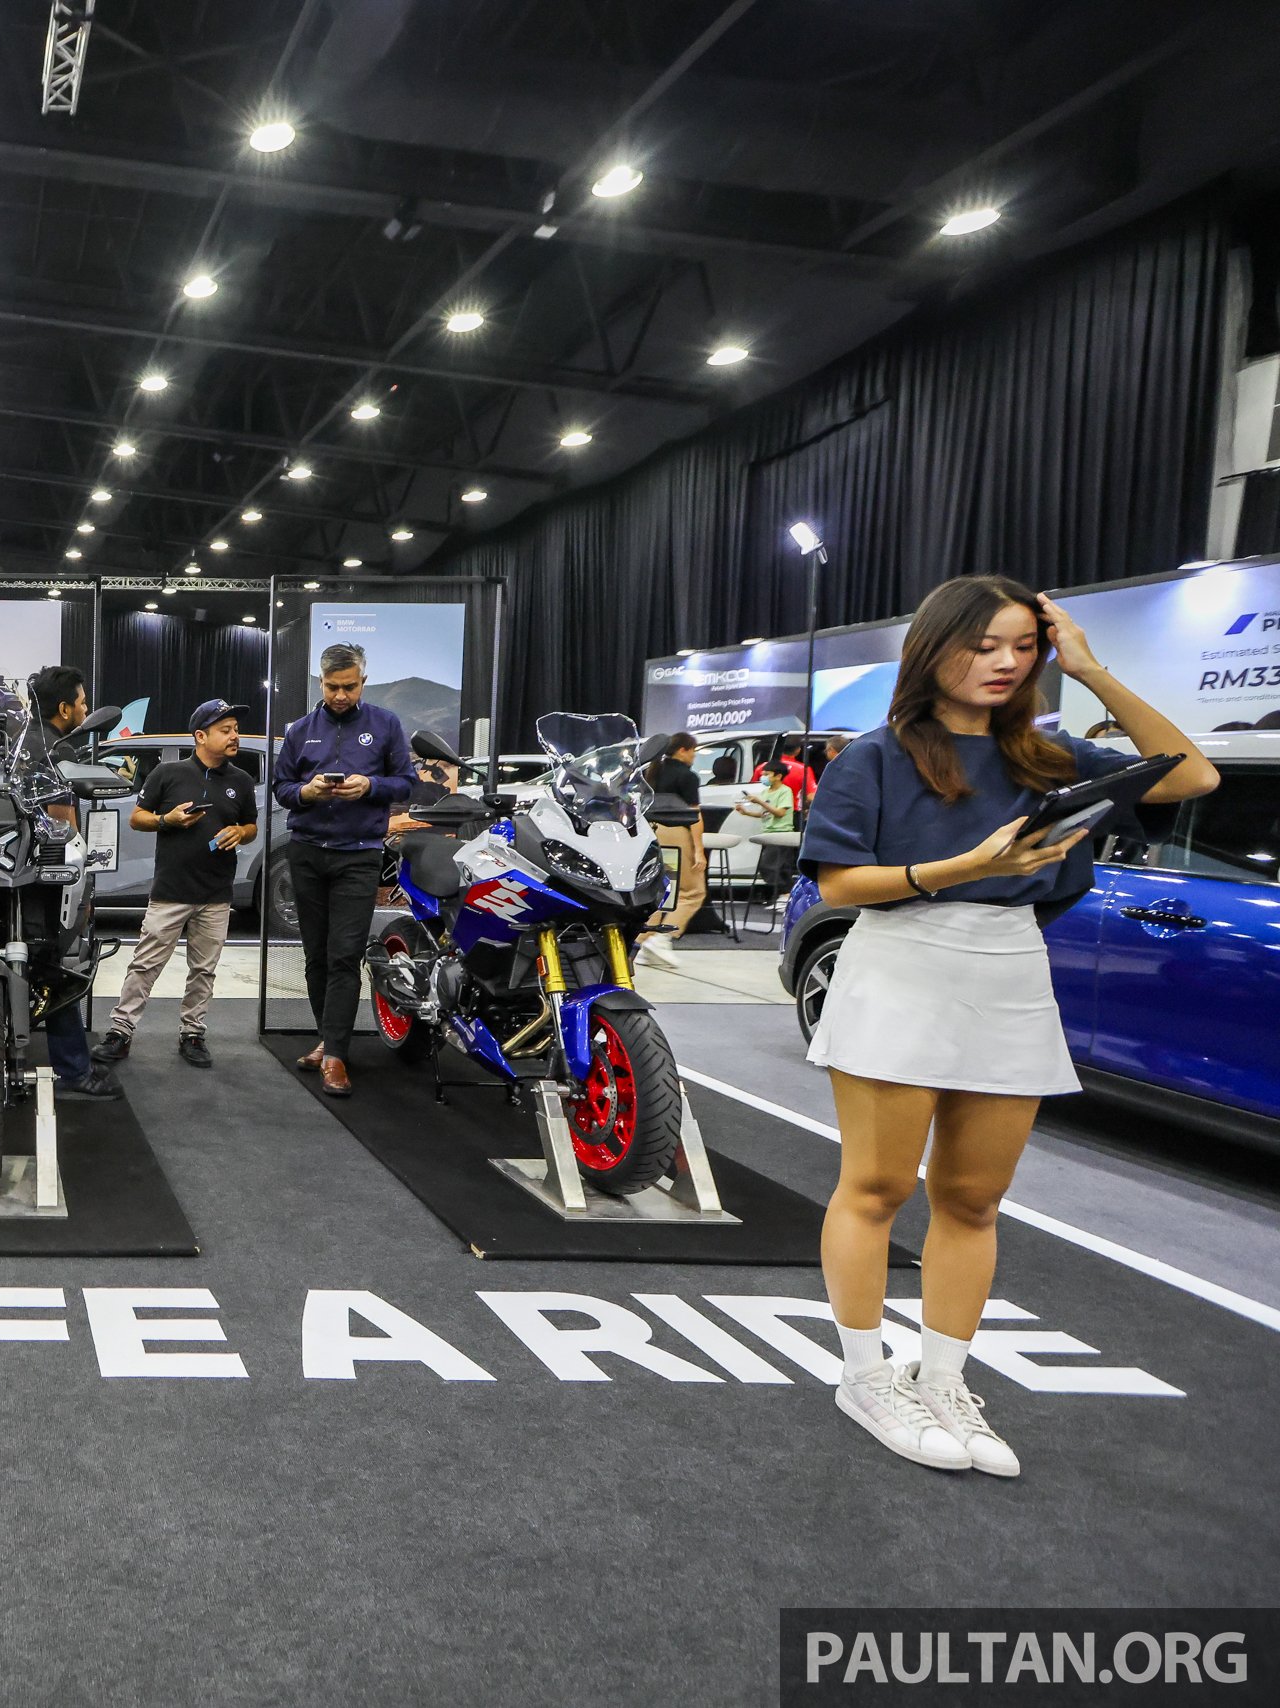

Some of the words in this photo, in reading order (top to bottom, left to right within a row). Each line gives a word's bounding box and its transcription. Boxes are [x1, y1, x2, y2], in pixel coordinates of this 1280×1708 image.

[1200, 645, 1269, 660] Estimated
[664, 665, 685, 677] GAC
[1198, 665, 1280, 691] RM33
[687, 701, 711, 710] Estimated
[711, 700, 728, 708] Selling
[741, 697, 755, 705] From
[301, 1289, 498, 1381] A
[475, 1290, 1188, 1398] RIDE
